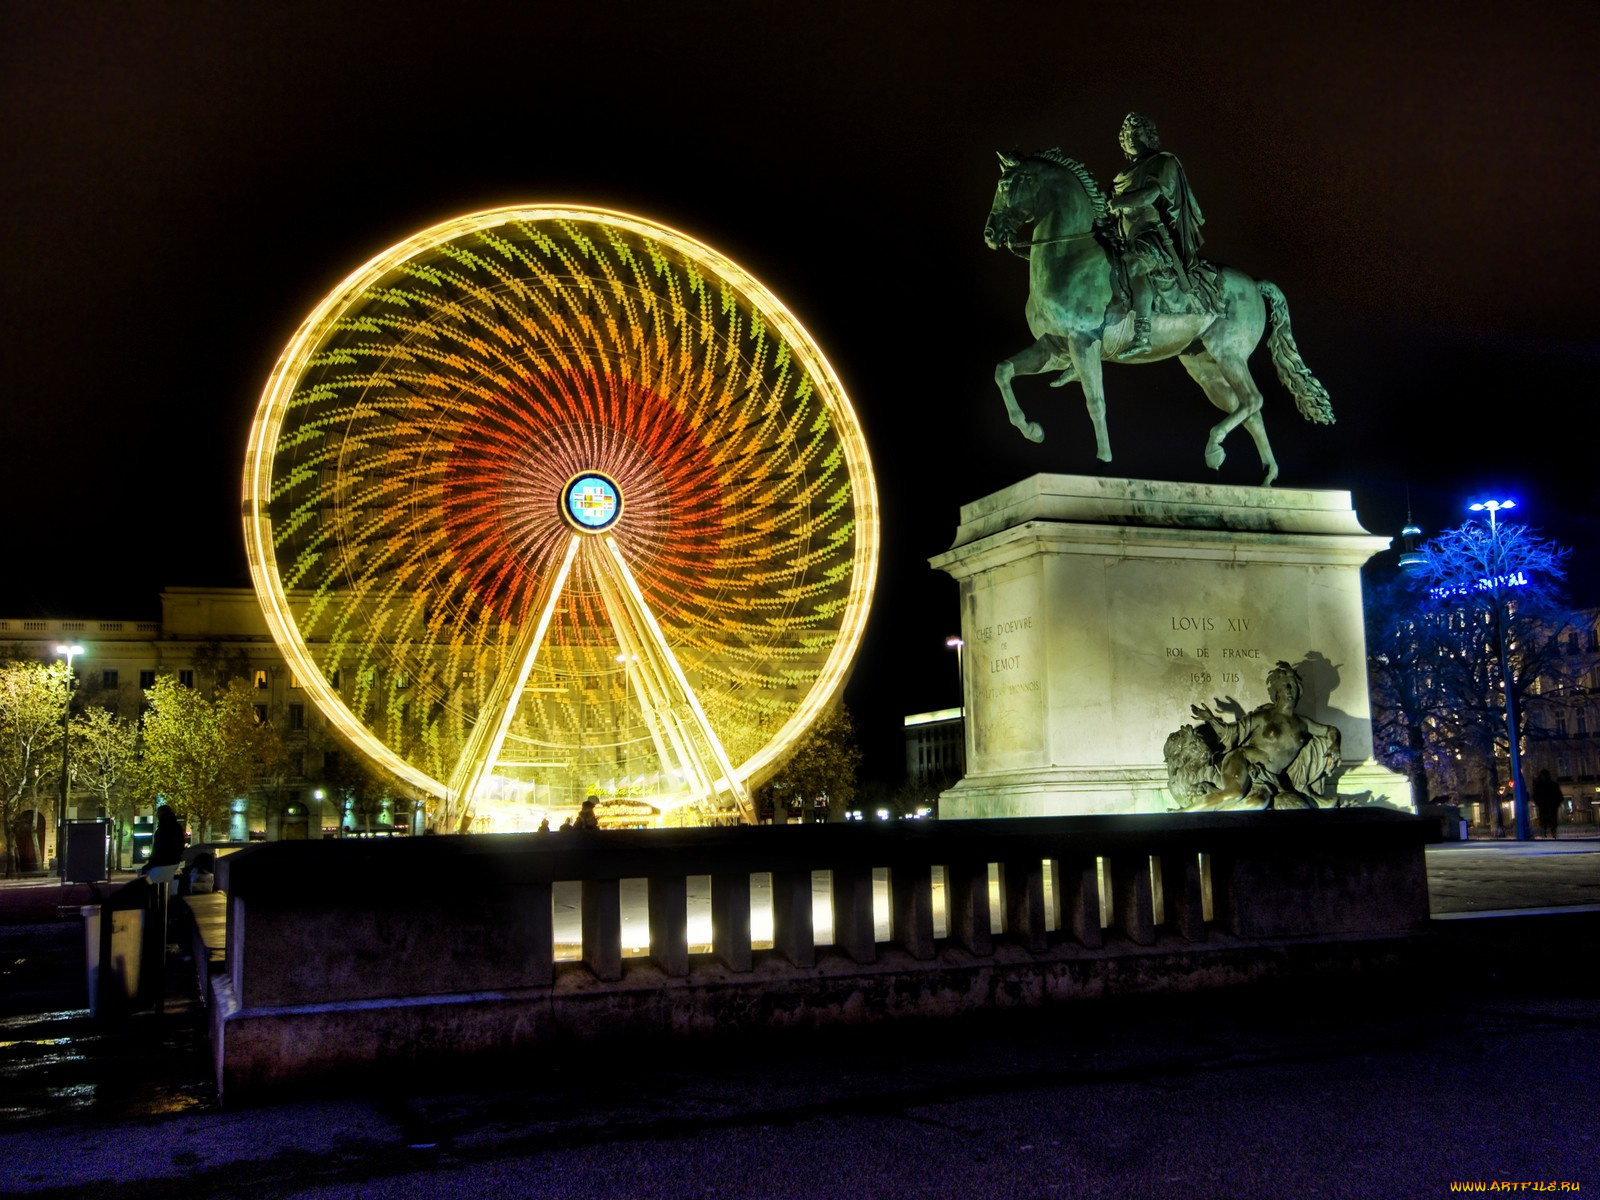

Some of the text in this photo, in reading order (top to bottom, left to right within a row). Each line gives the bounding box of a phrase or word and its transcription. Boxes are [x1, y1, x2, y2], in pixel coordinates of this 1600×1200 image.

[1172, 617, 1251, 631] LOVIS XIV
[1166, 647, 1260, 659] ROI DE FRANCE
[990, 656, 1020, 673] LEMOT
[1190, 673, 1240, 683] 1638 1715
